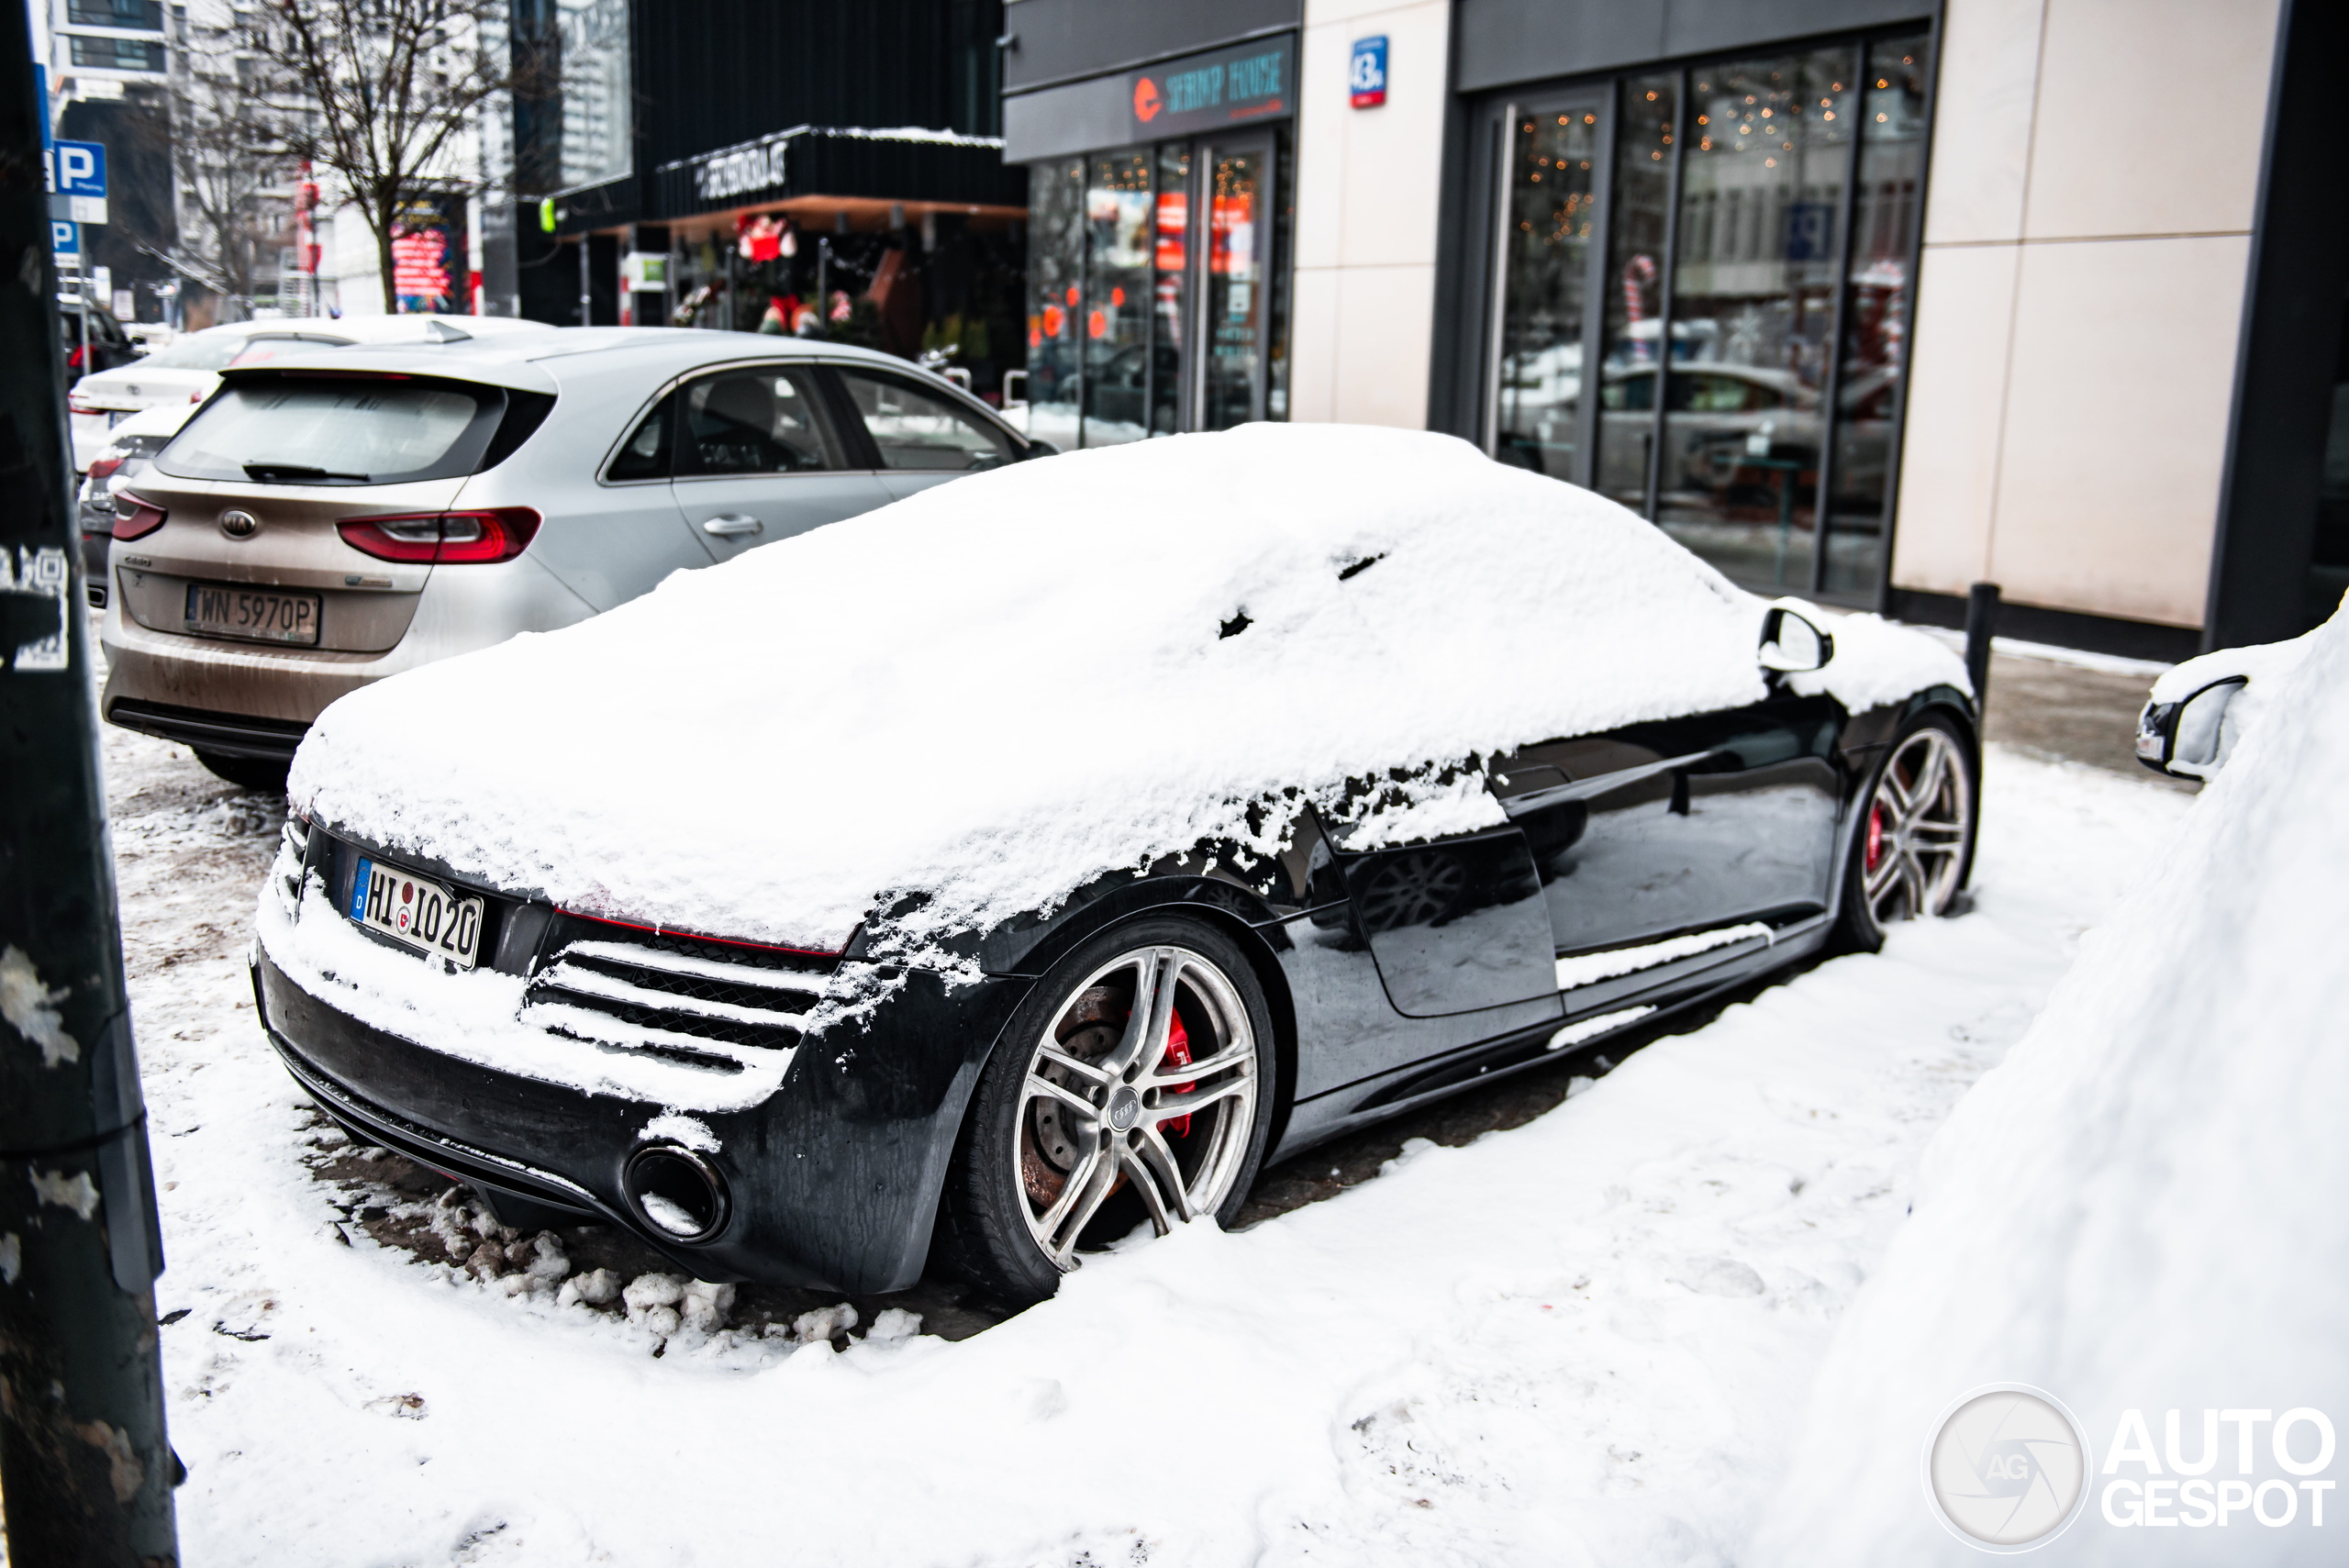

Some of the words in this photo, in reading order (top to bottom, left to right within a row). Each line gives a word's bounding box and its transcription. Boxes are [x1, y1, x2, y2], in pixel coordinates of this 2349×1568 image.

[60, 147, 95, 189] P
[52, 222, 73, 250] P
[224, 515, 248, 531] KIA
[201, 588, 230, 623] WN
[238, 594, 310, 631] 5970P
[356, 895, 362, 909] D
[366, 871, 397, 927] HI
